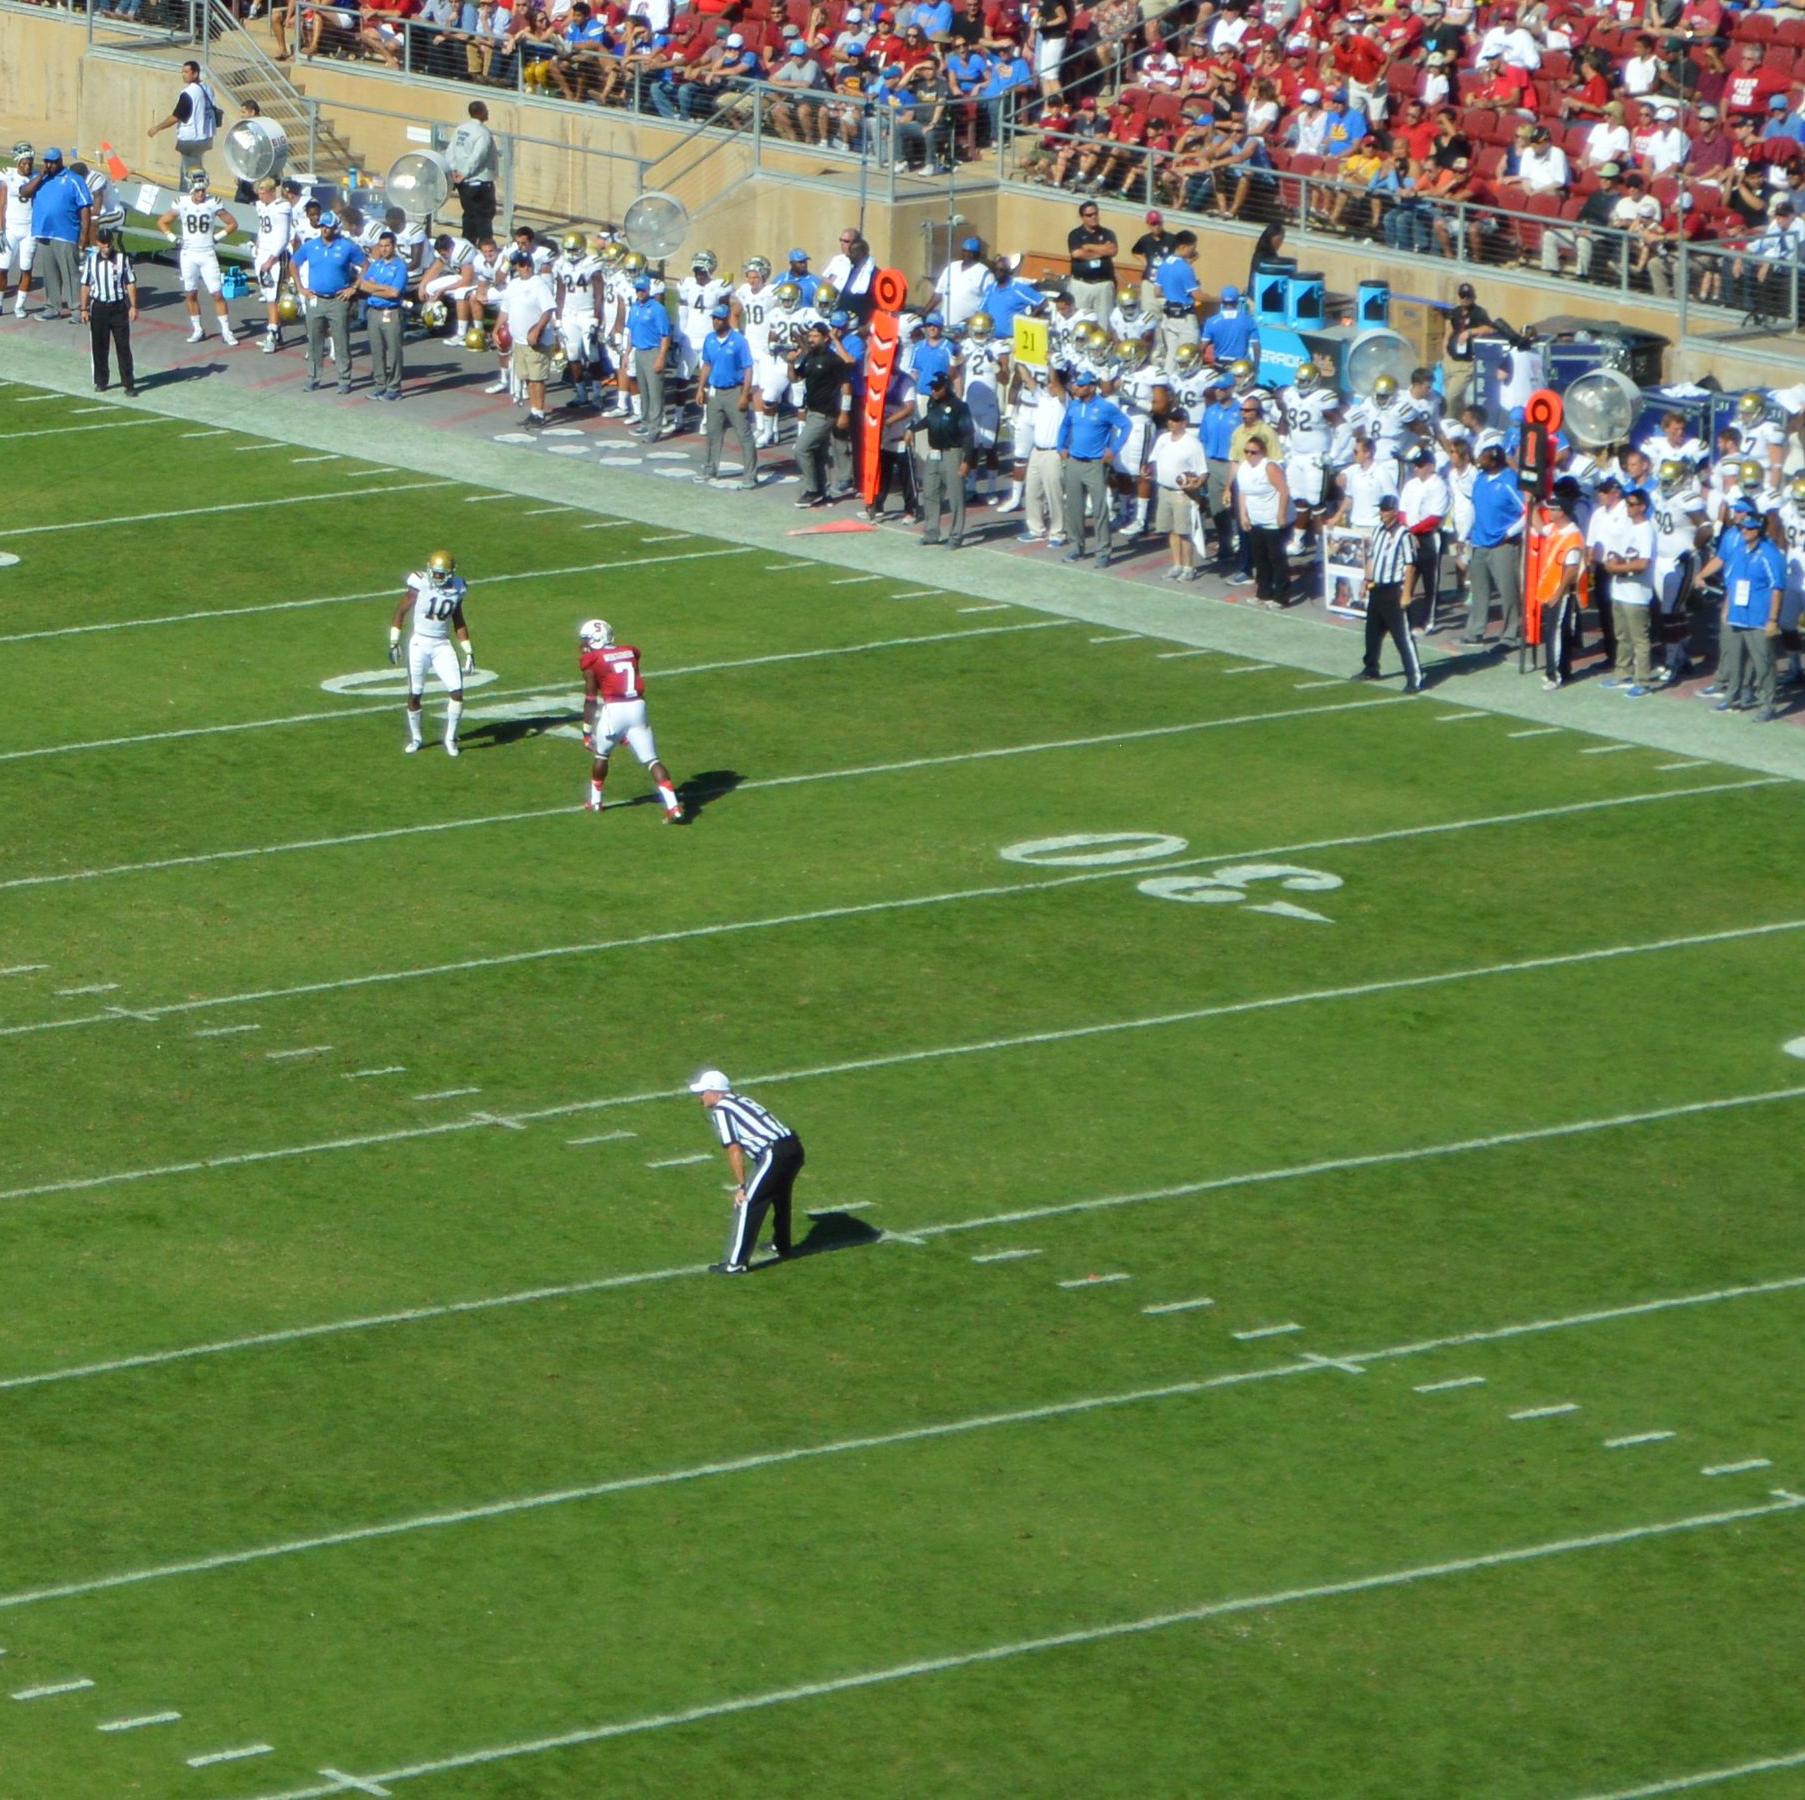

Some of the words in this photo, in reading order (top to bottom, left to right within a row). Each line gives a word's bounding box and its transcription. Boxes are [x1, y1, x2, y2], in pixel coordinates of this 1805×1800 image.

[187, 213, 211, 234] 86
[564, 274, 587, 293] 24
[693, 294, 705, 314] 4
[1022, 330, 1036, 351] 21
[427, 597, 451, 621] 10
[617, 661, 637, 697] 7
[997, 831, 1344, 903] 30
